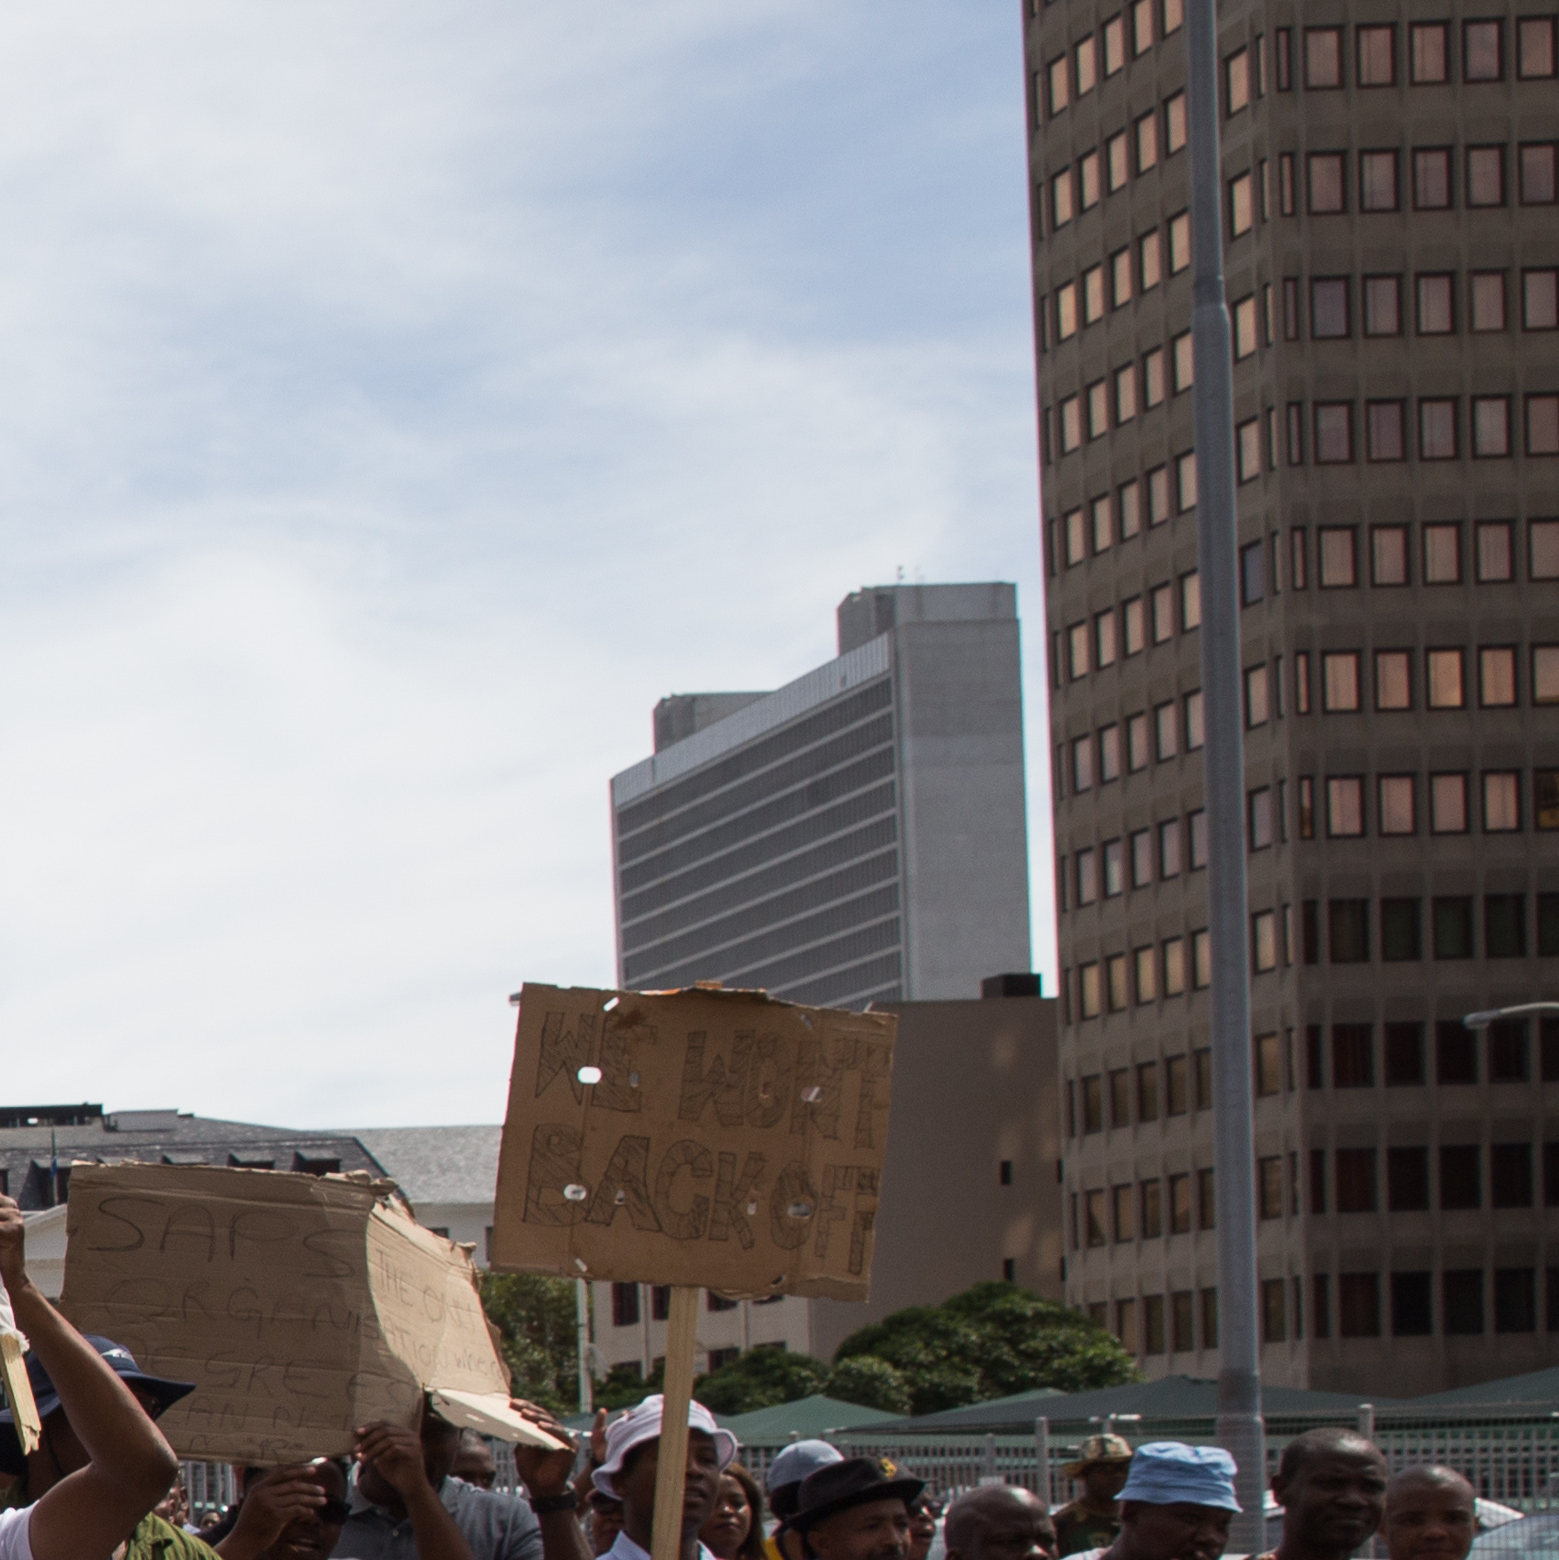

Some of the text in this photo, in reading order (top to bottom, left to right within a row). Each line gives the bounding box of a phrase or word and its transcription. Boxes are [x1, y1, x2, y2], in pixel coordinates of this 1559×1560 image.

[534, 1010, 658, 1113] WE
[87, 1195, 363, 1279] SAPS
[375, 1248, 414, 1307] THE
[522, 1122, 881, 1275] BACK OFF
